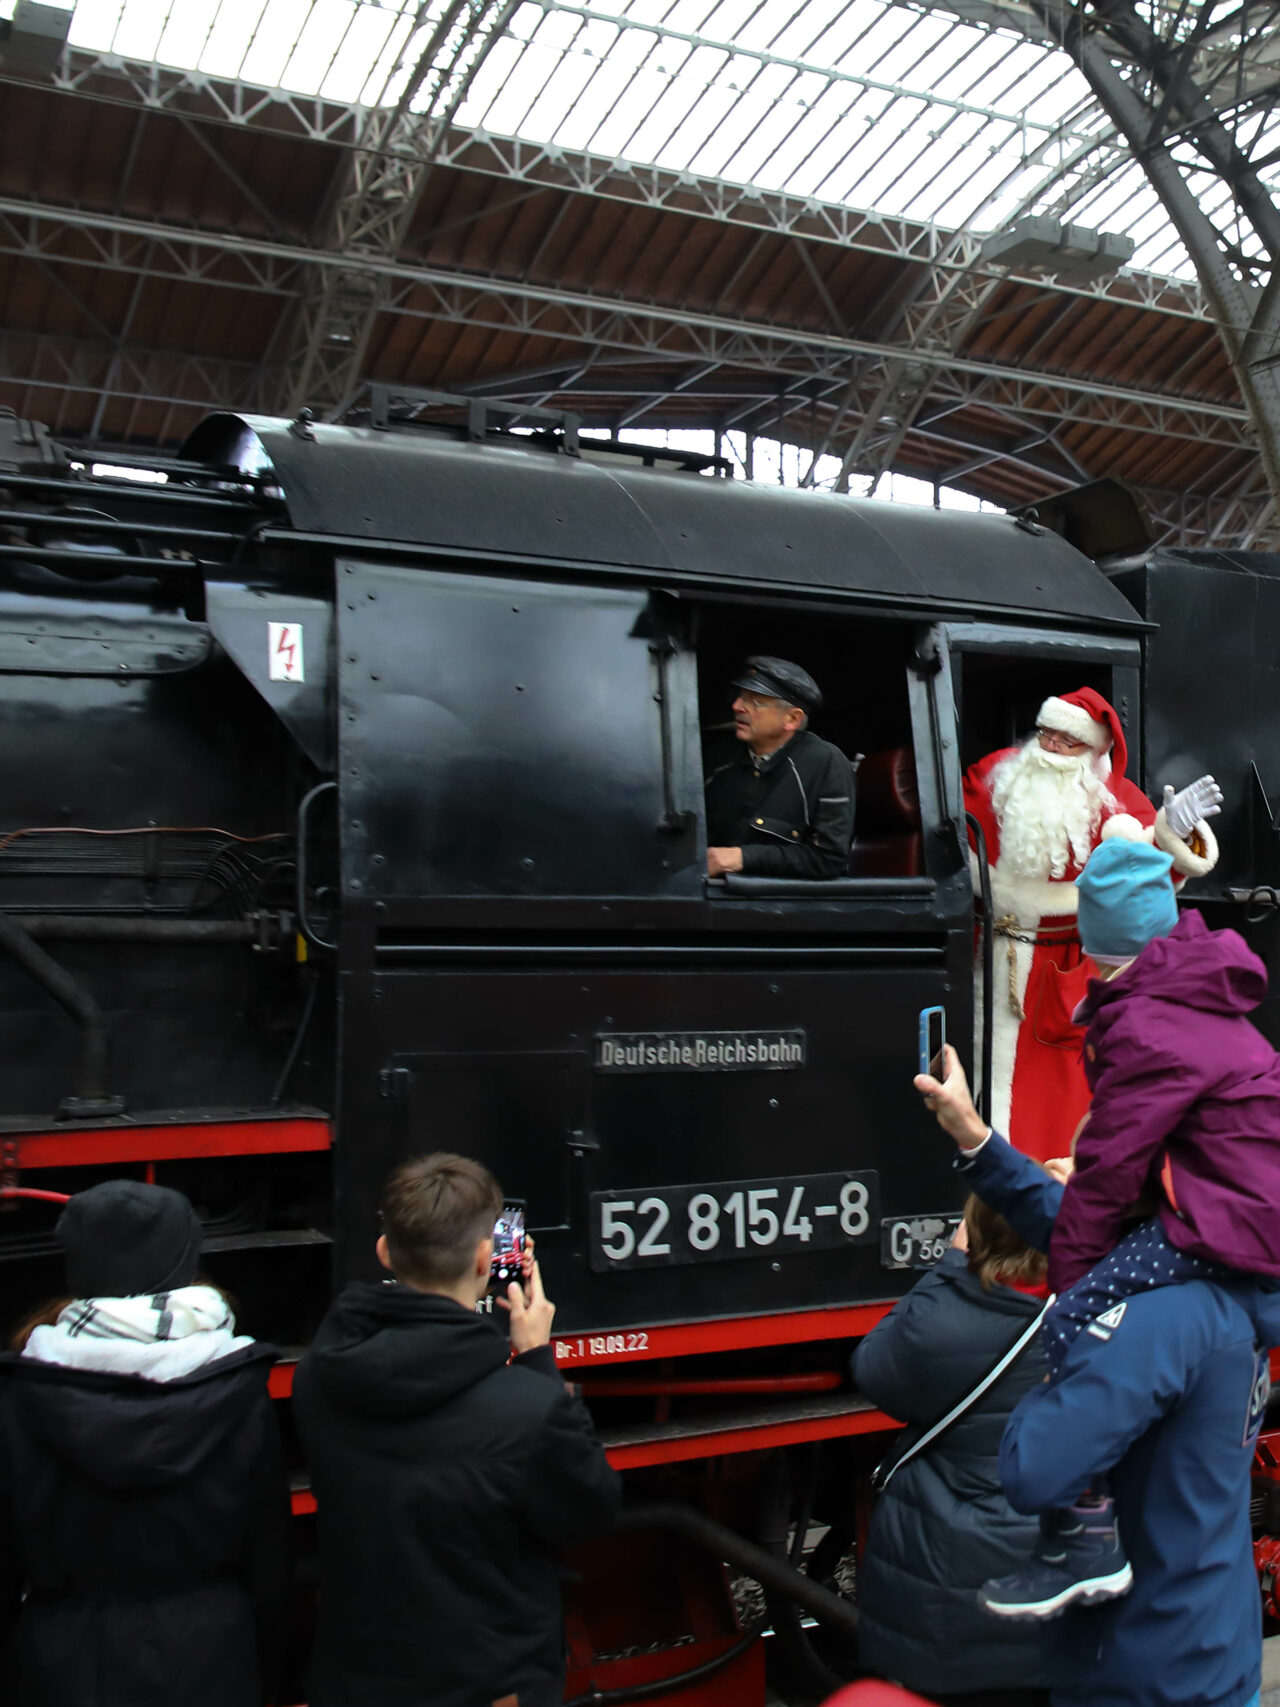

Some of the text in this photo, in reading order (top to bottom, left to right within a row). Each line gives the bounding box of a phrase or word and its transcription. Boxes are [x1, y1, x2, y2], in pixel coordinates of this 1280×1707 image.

[601, 1037, 802, 1066] Deutsche Reichsbahn
[601, 1181, 869, 1261] 52 8154-8
[890, 1221, 913, 1263] G
